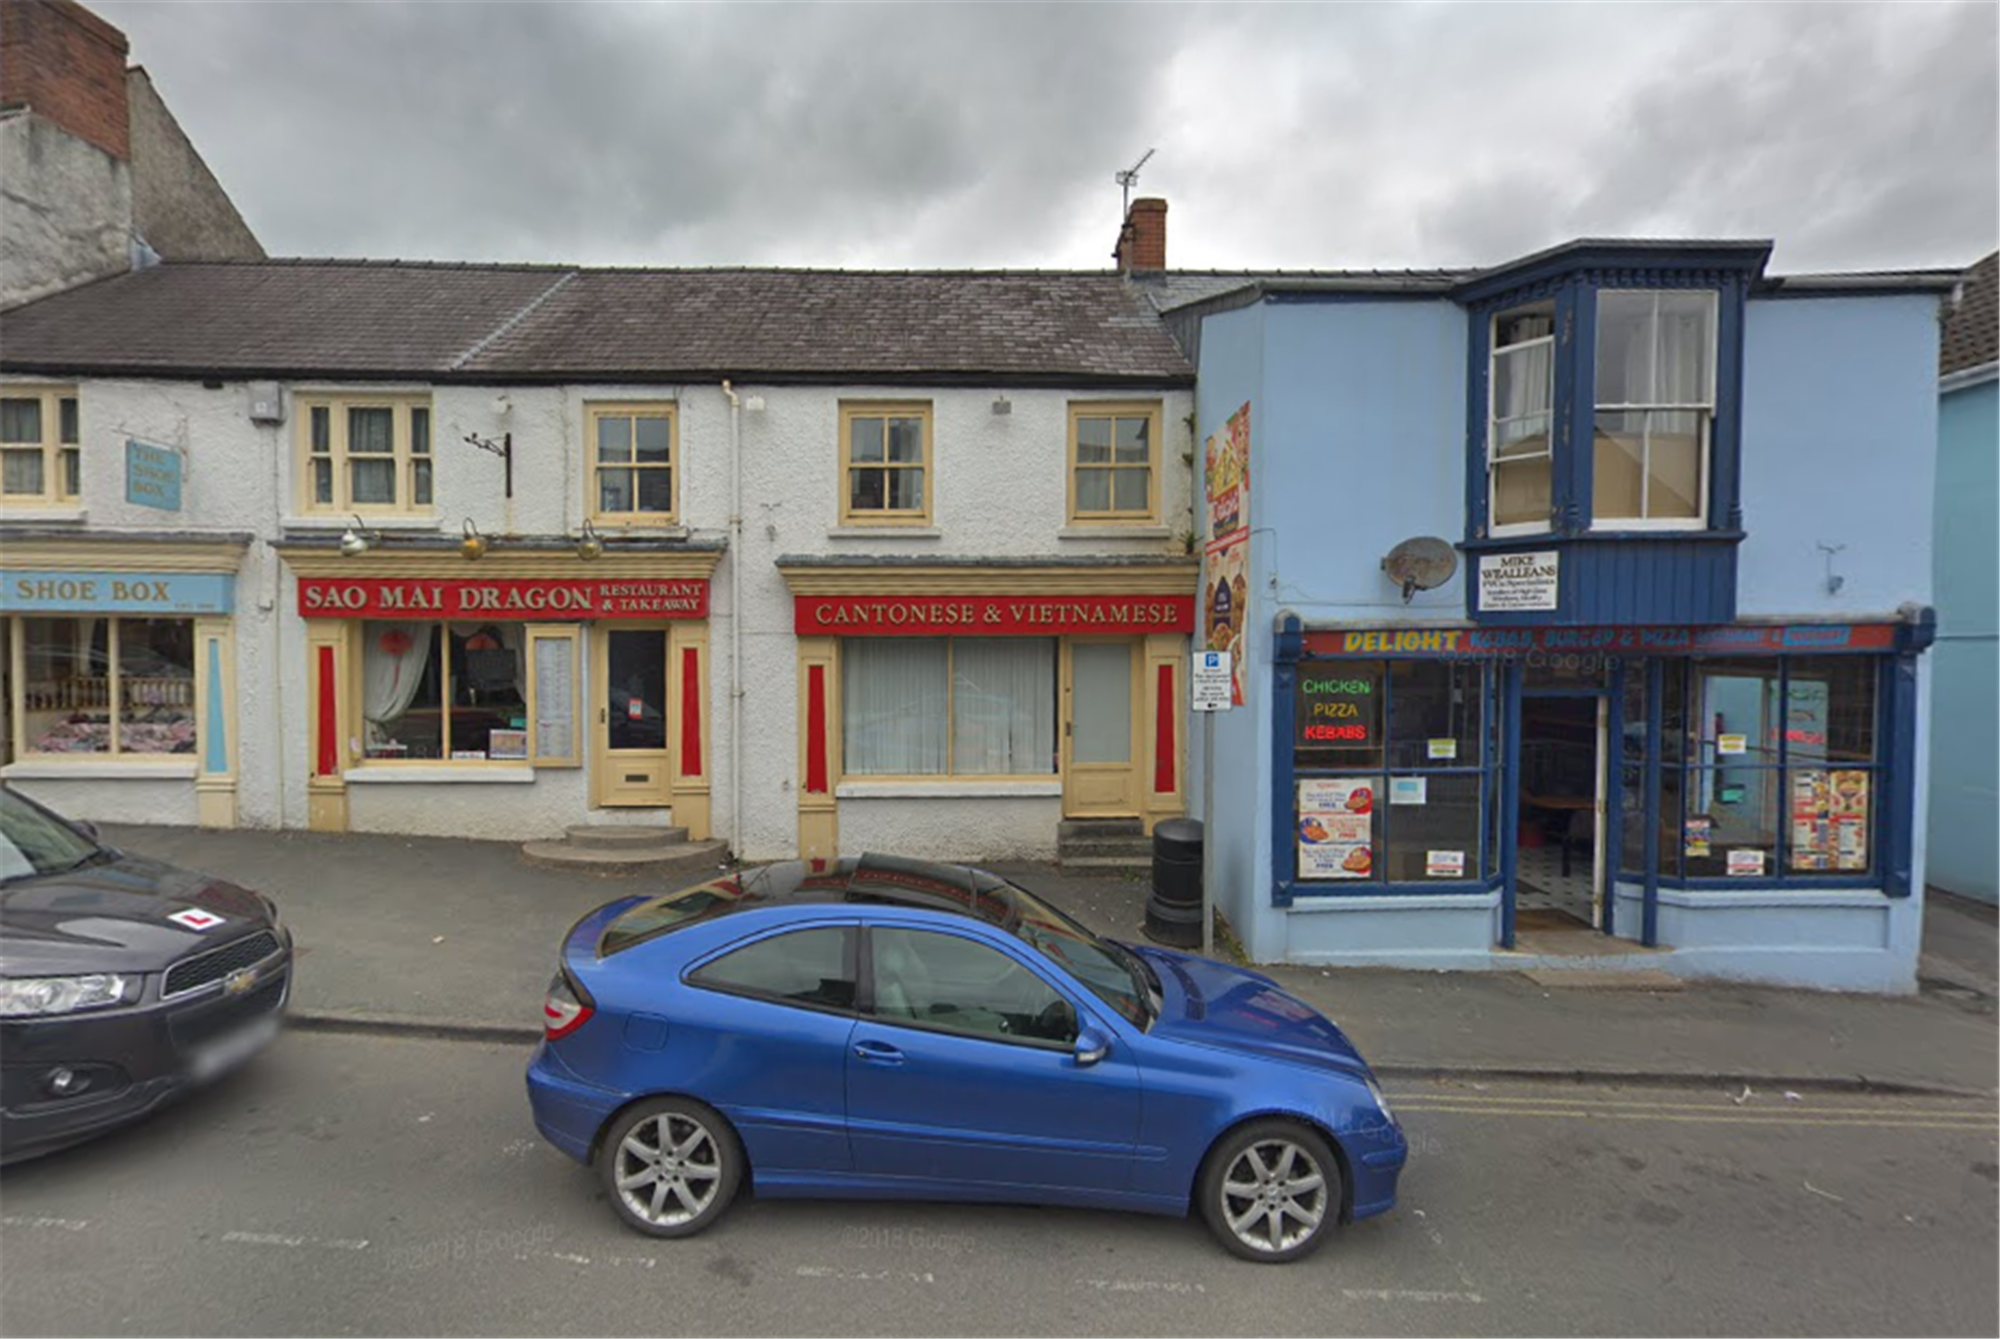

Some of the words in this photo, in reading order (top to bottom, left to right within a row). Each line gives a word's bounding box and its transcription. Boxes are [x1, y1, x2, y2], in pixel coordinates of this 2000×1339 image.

[131, 462, 177, 484] SHOE
[132, 480, 165, 497] BOX
[1501, 556, 1534, 568] MIKE
[16, 579, 98, 601] SHOE
[112, 581, 171, 601] BOX
[305, 585, 368, 610] SAO
[379, 585, 443, 610] MAI
[459, 586, 593, 610] DRAGON
[600, 583, 702, 597] RESTAURANT
[602, 599, 613, 611] &
[620, 598, 699, 612] TAKEAWAY
[815, 603, 975, 625] CANTONESE
[983, 603, 1003, 624] &
[1010, 603, 1178, 624] VIETNAMESE
[1343, 630, 1464, 652] DELIGHT
[1640, 629, 1690, 647] PIZZA
[1303, 679, 1372, 694] CHICKEN
[1313, 701, 1359, 718] PIZZA
[1305, 724, 1367, 740] KEBABS
[181, 913, 213, 927] L
